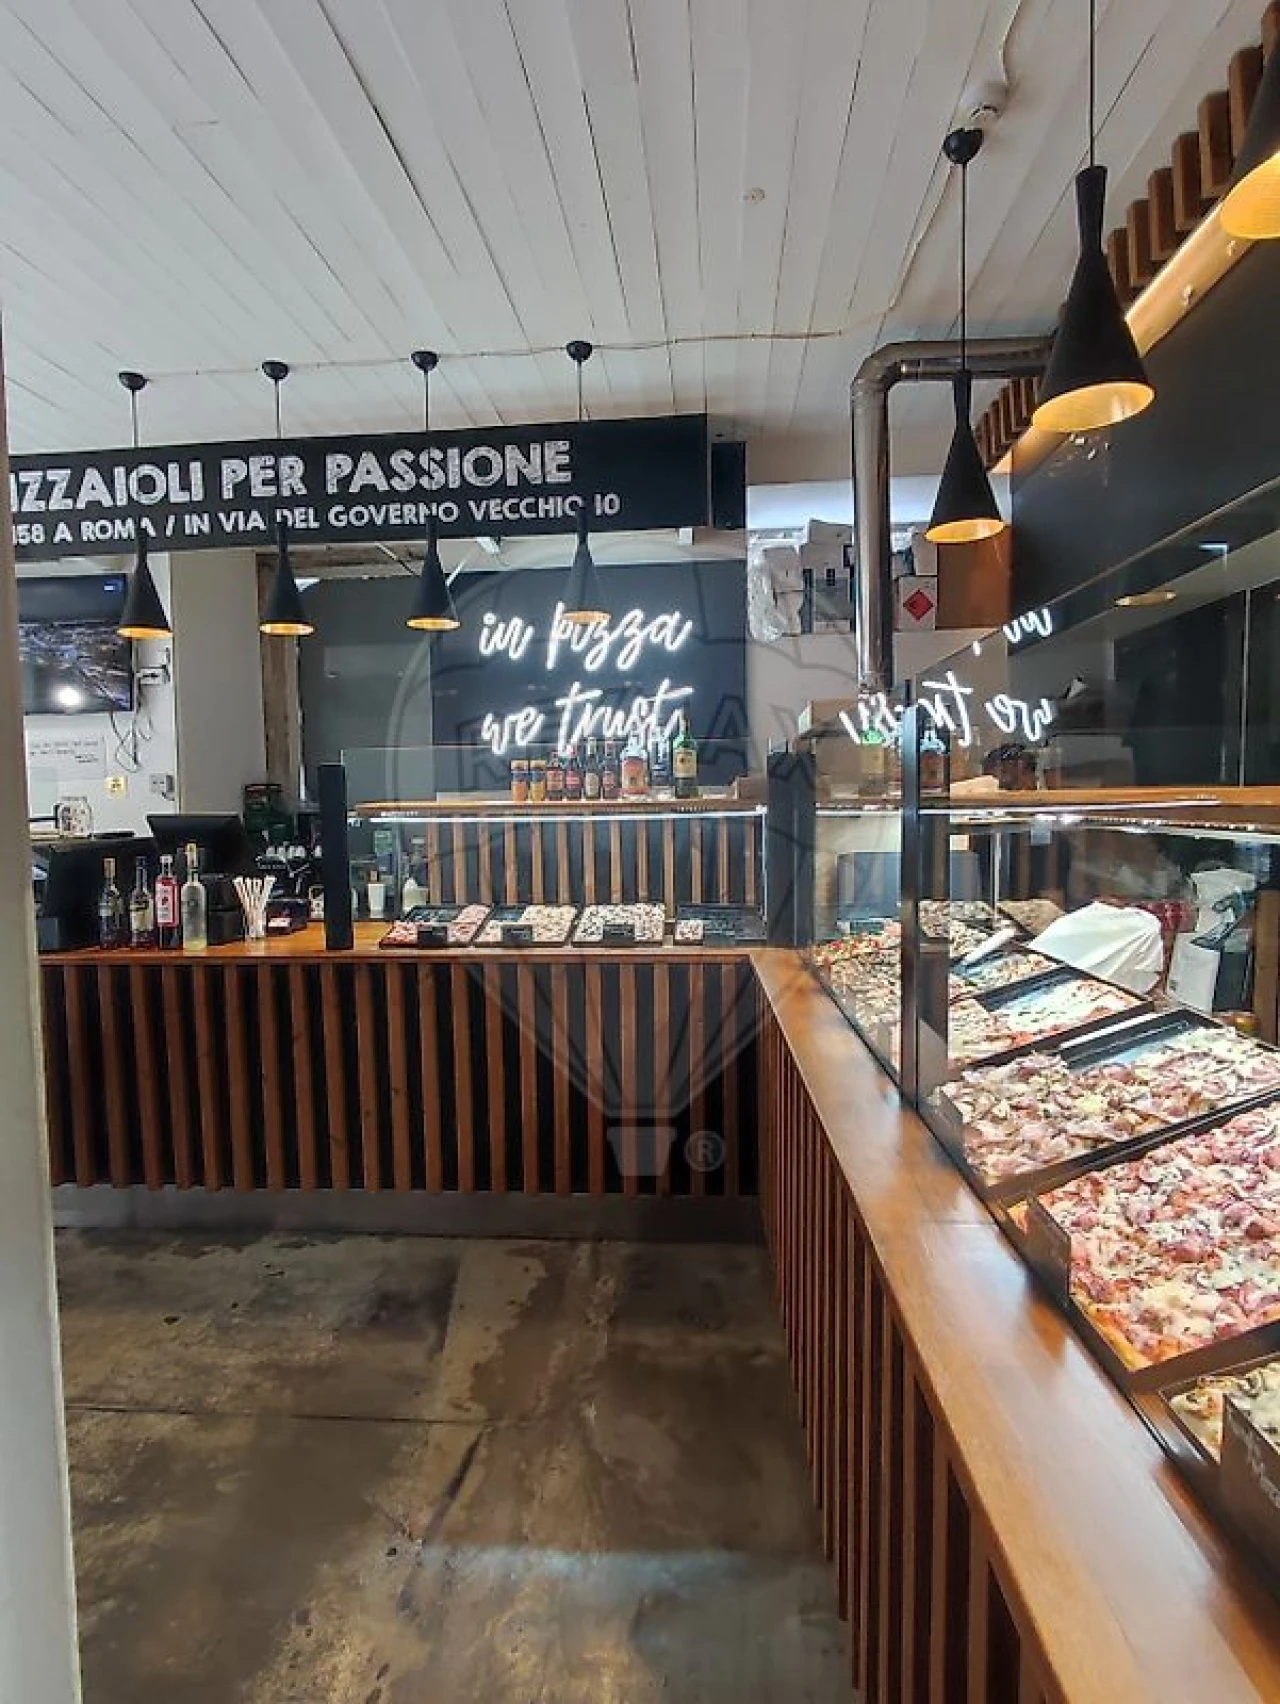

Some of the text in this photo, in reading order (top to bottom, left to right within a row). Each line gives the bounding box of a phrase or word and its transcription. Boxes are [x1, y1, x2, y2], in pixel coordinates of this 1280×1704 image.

[221, 455, 307, 499] PER
[326, 440, 572, 495] PASSIONE
[53, 521, 73, 543] A
[165, 514, 175, 537] /
[185, 512, 210, 536] IN
[217, 510, 266, 533] VIA
[327, 501, 459, 527] GOVERNO
[468, 495, 582, 521] VECCHIO
[478, 600, 693, 671] in pizza
[480, 677, 694, 760] we trust
